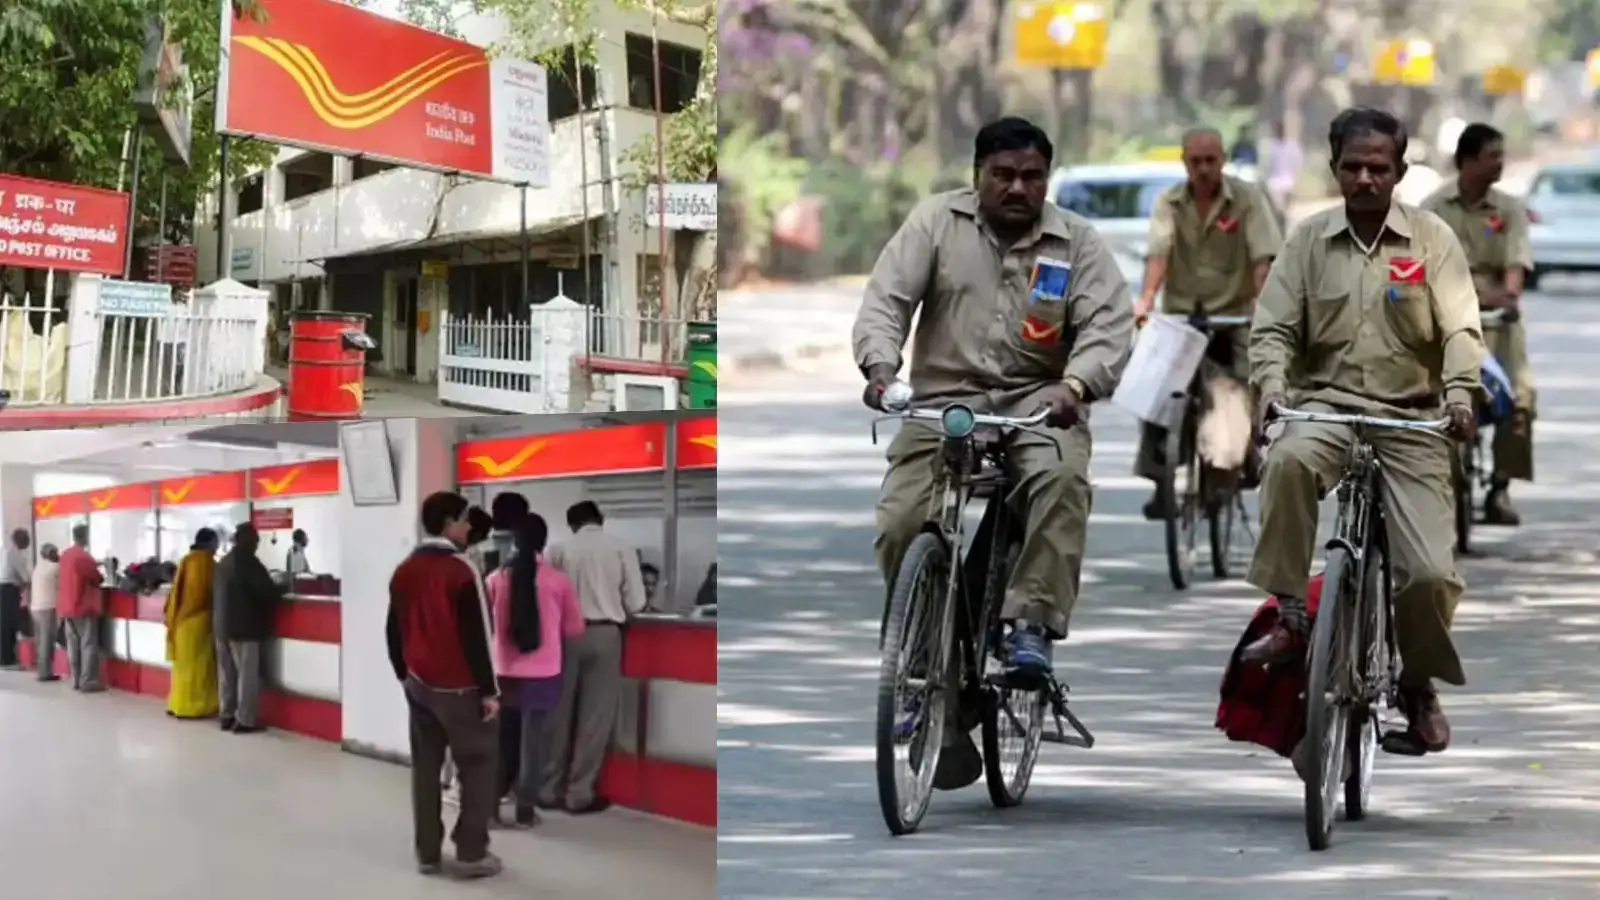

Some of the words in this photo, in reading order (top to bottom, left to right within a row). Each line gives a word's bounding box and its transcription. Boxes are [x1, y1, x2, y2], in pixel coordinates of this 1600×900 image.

[425, 122, 453, 140] India
[454, 128, 476, 147] Post
[8, 240, 42, 256] POST
[44, 244, 92, 262] OFFICE
